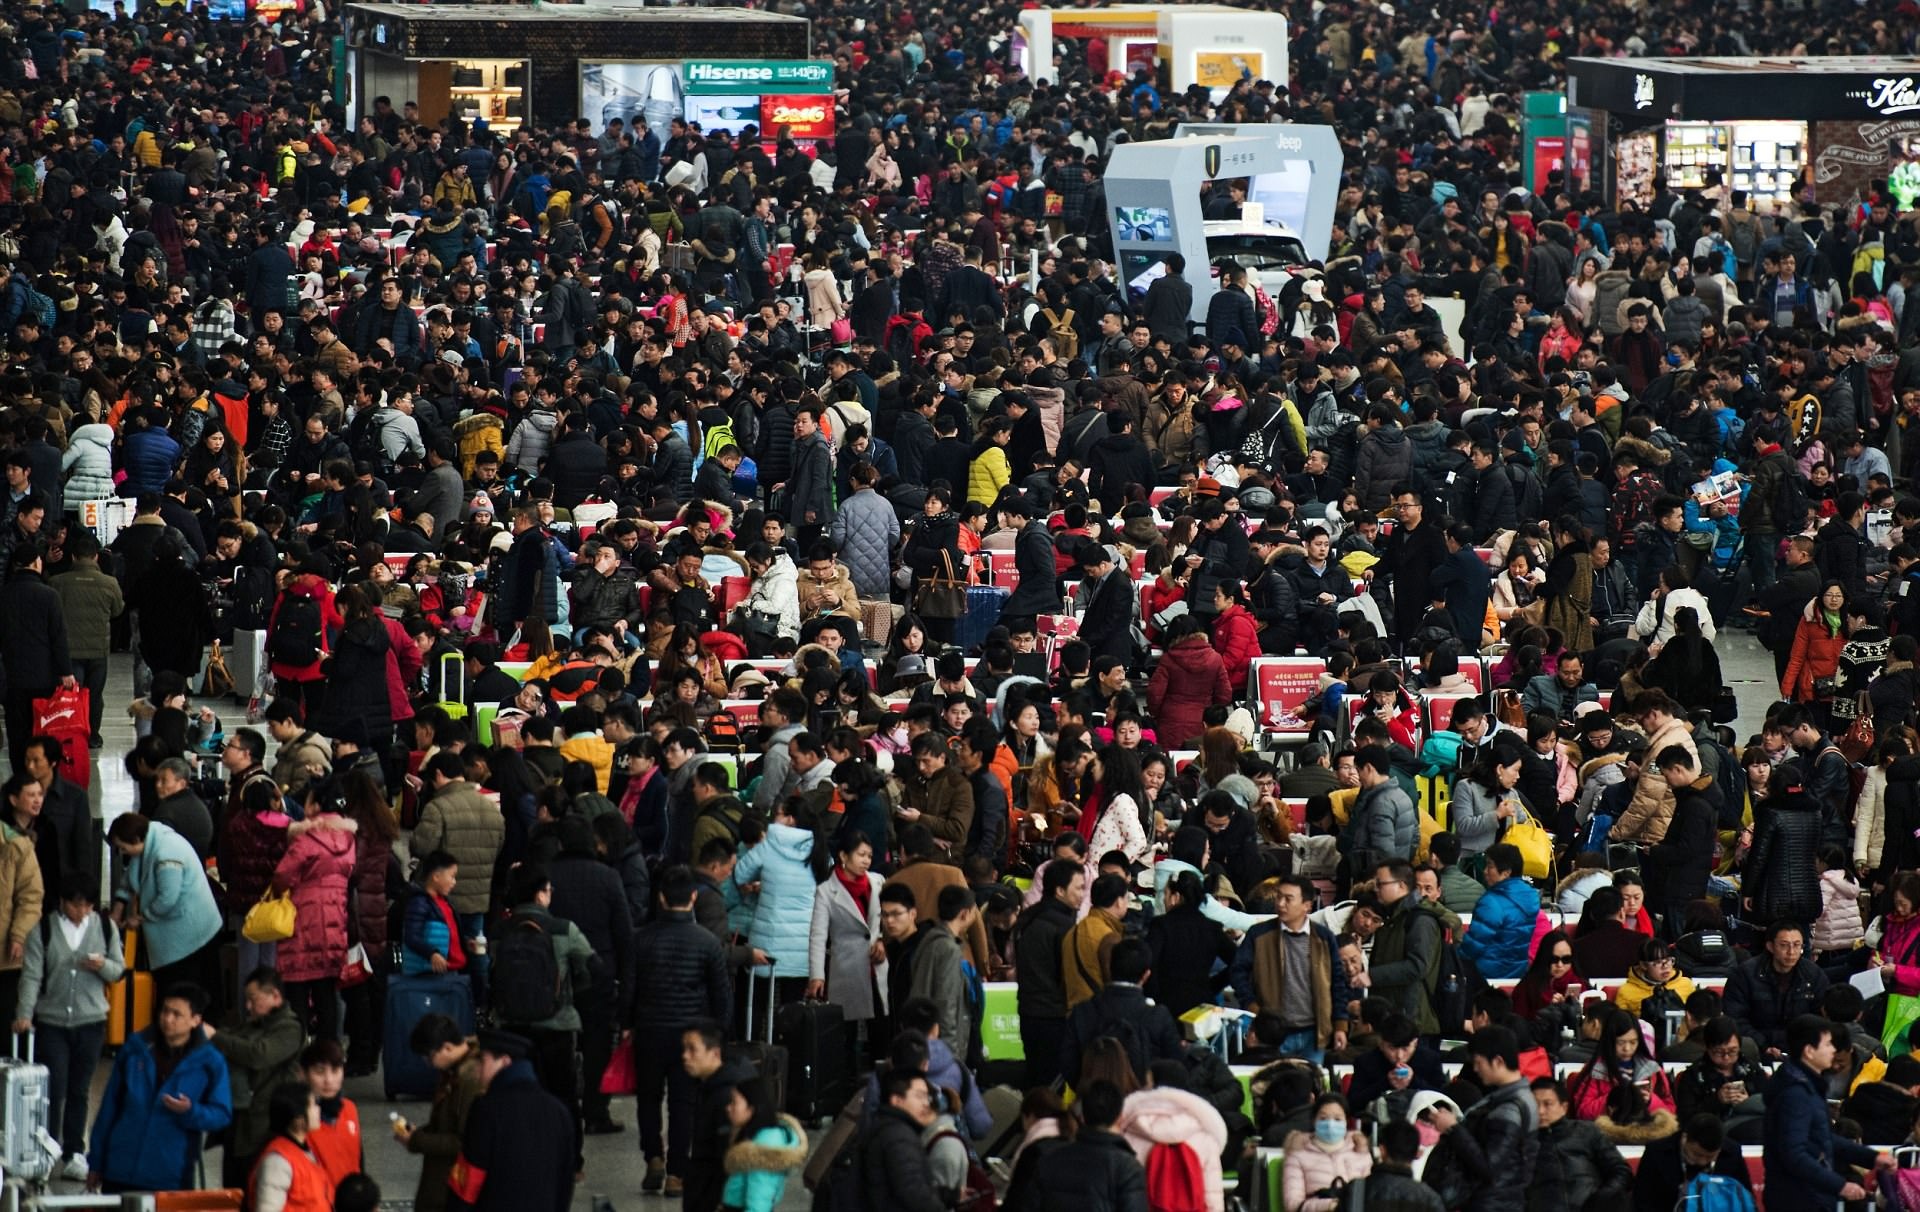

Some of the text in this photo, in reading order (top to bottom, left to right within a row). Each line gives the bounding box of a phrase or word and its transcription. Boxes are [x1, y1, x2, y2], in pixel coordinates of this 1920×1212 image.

[690, 64, 773, 79] Hisense
[771, 106, 825, 123] 2016
[1278, 133, 1302, 152] Jeep
